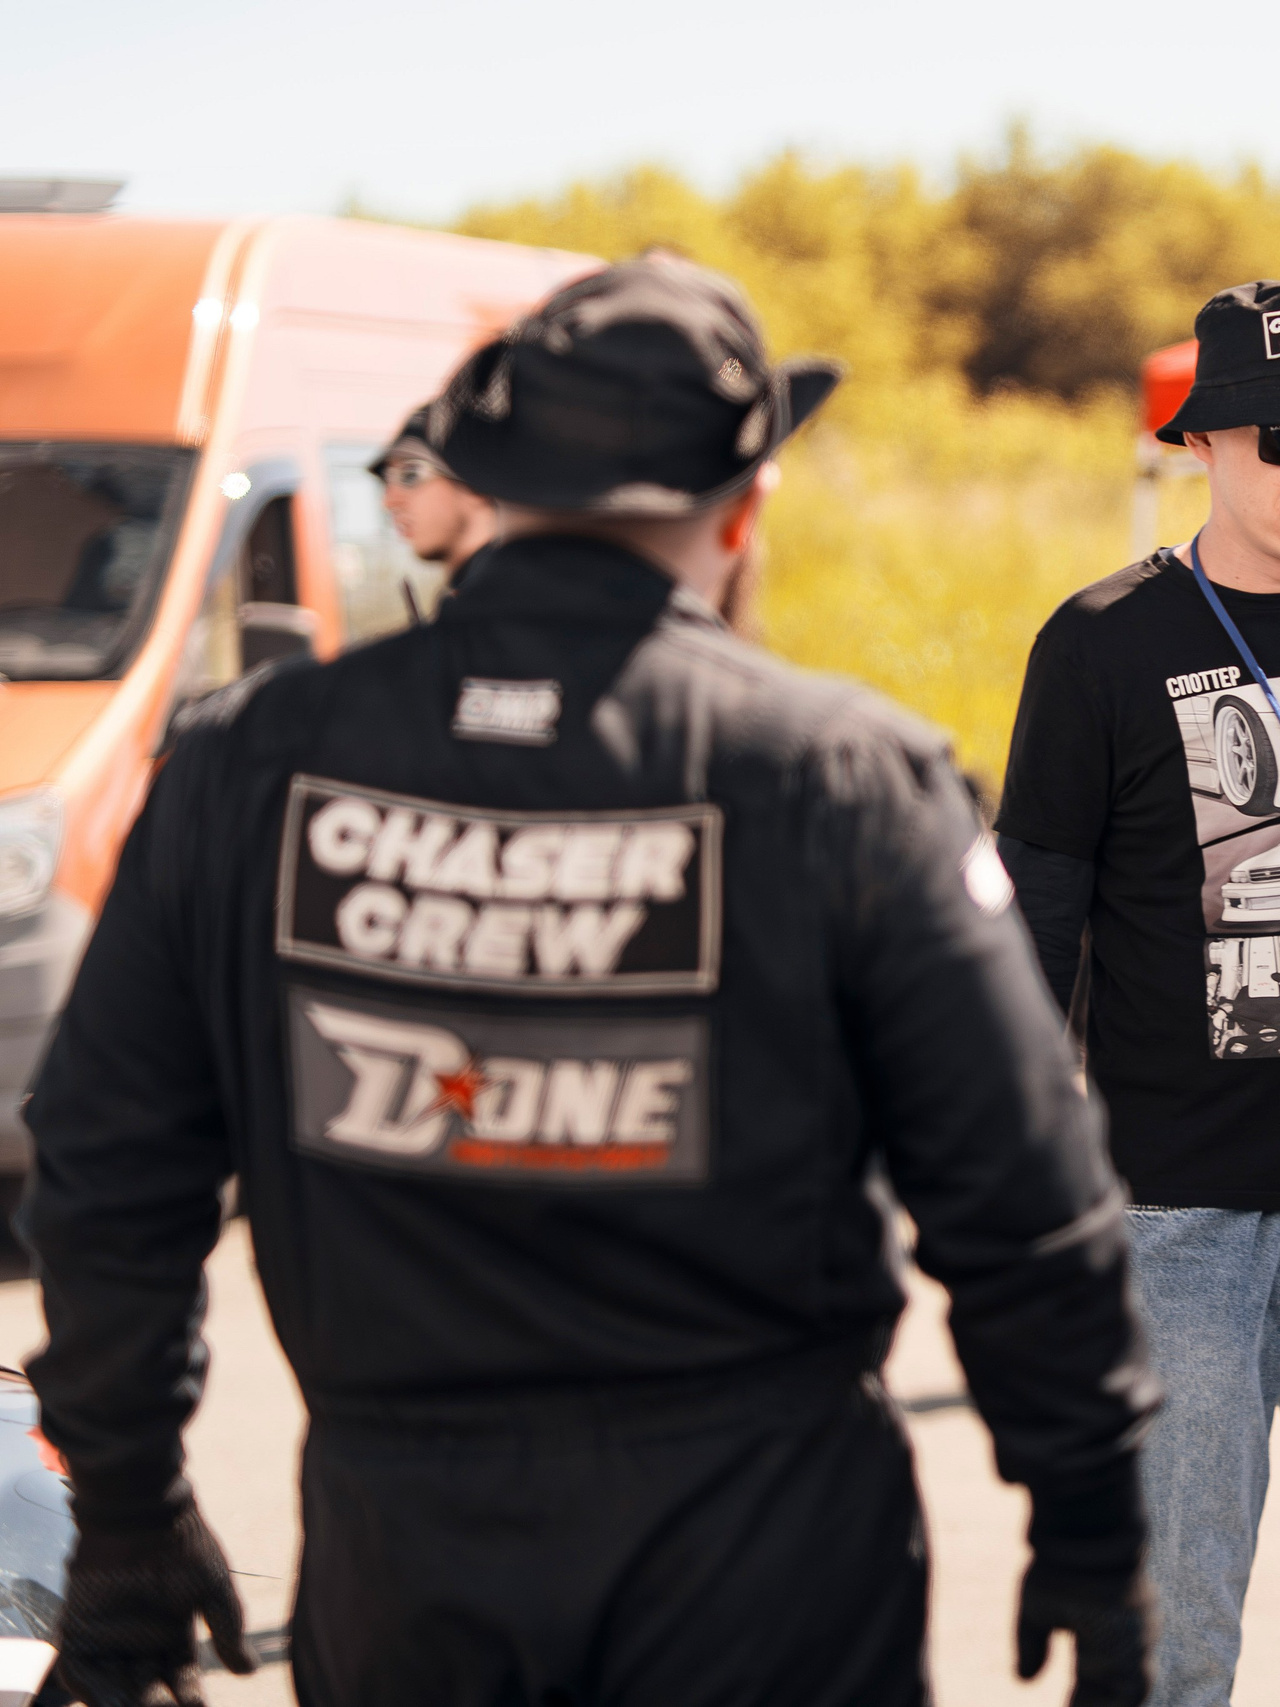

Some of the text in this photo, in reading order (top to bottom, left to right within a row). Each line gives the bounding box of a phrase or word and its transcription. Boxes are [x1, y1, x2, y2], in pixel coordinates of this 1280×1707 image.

[1166, 666, 1241, 698] СПОТТЕР
[308, 797, 695, 902] CHASER
[336, 881, 647, 977] CREW
